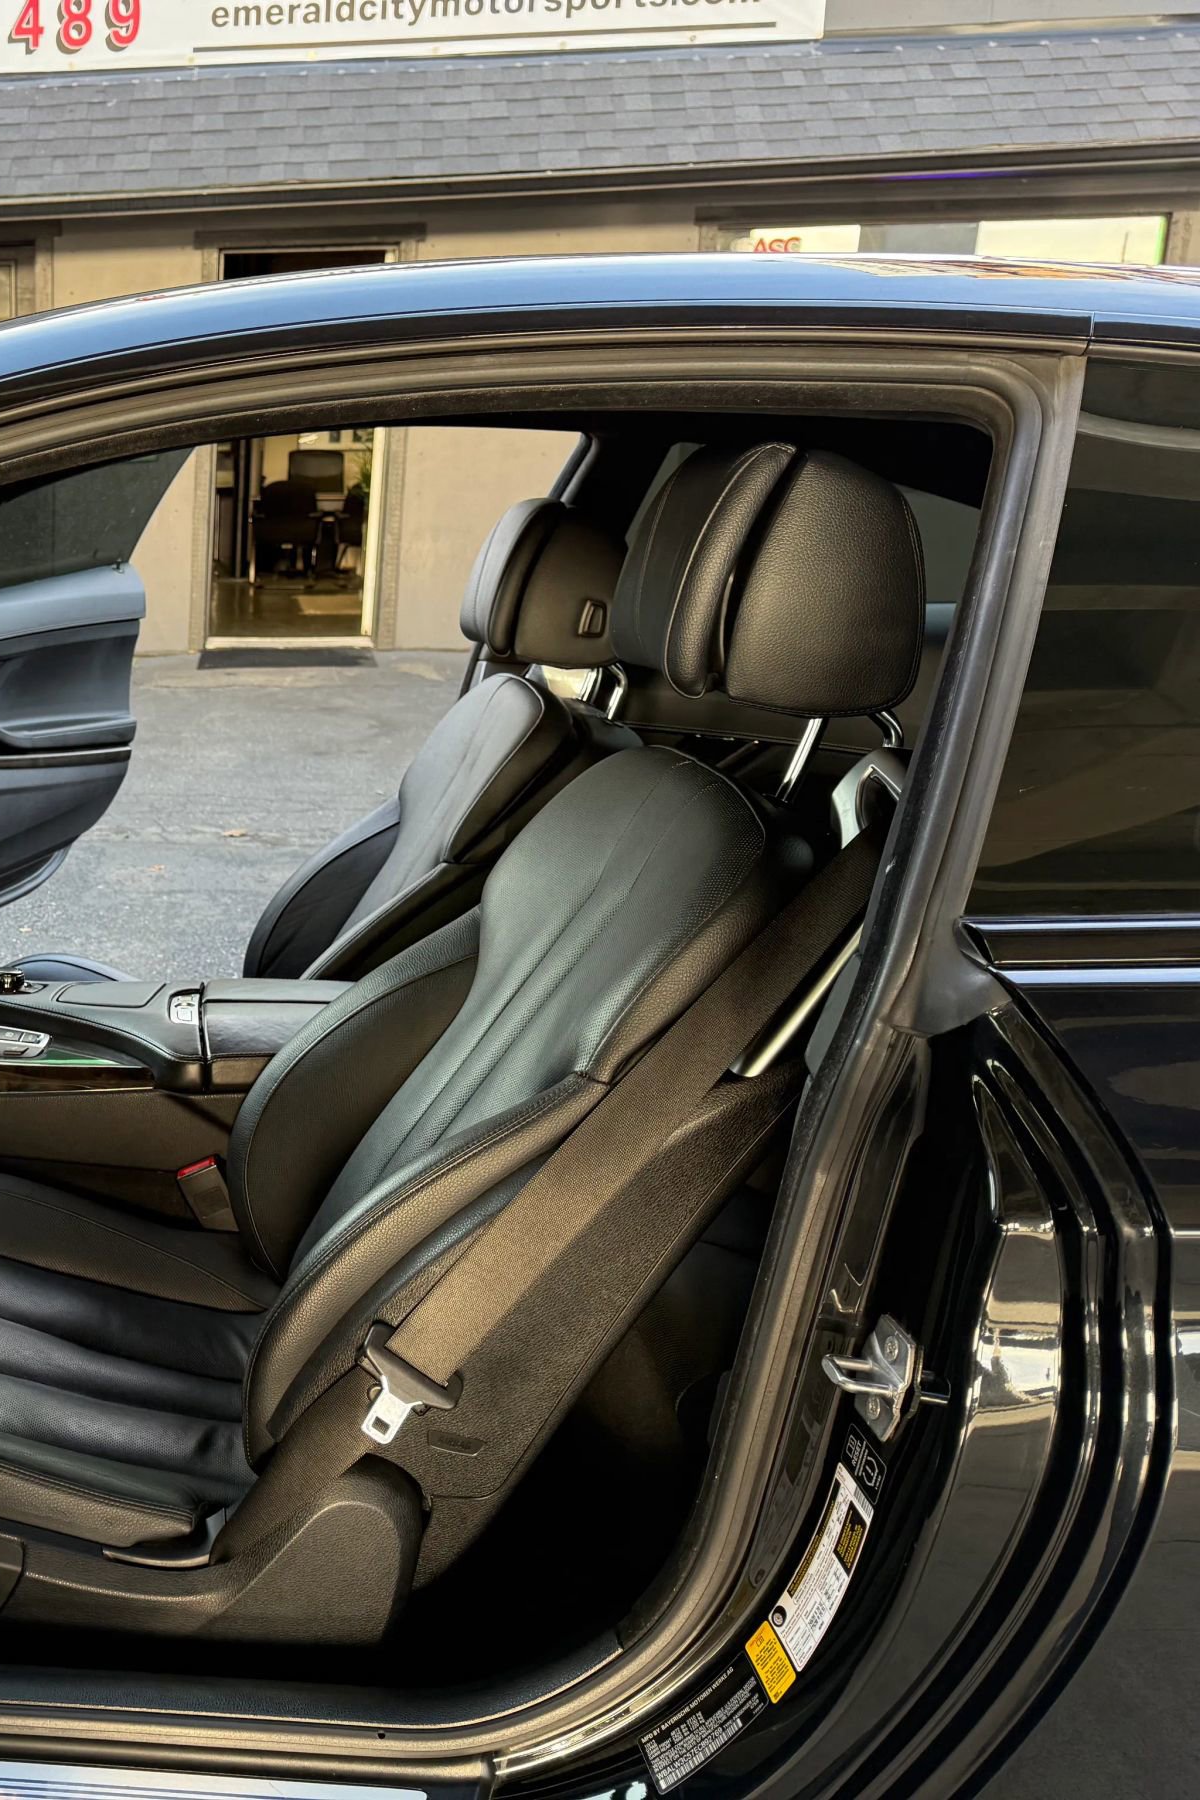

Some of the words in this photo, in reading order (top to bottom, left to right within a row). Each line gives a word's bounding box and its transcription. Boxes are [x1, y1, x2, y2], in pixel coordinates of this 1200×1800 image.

[660, 1705, 690, 1730] BAYERISCHE
[688, 1686, 713, 1709] MOTOREN
[710, 1672, 728, 1689] WERKE
